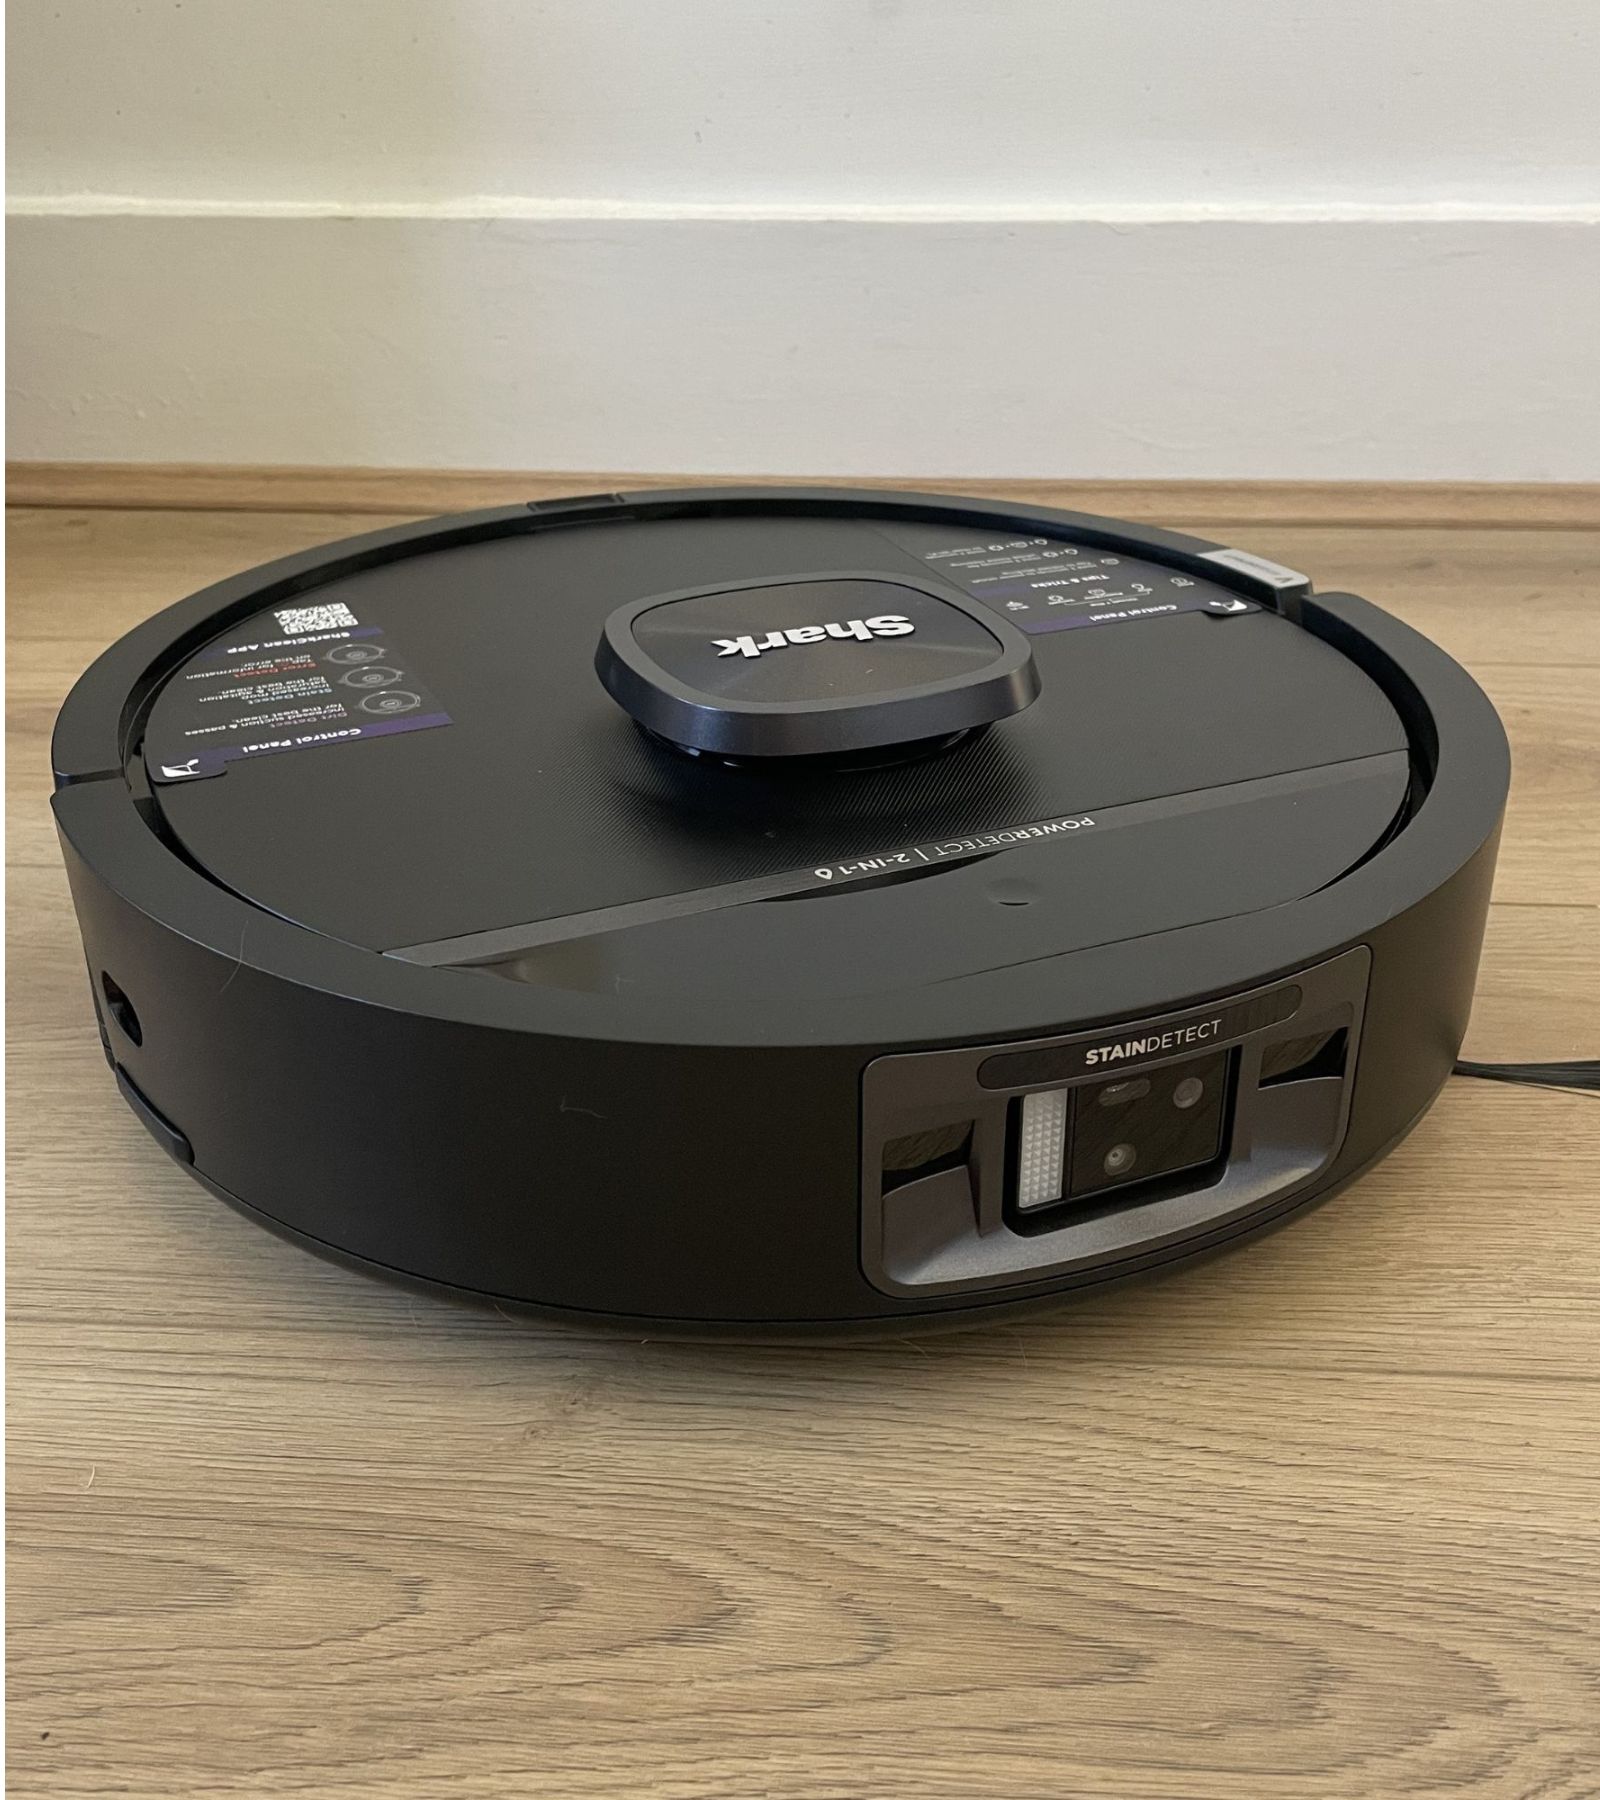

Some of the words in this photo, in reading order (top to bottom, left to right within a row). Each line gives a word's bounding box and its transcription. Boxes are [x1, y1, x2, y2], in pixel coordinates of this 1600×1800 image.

[1089, 611, 1128, 622] Panel
[1127, 604, 1178, 617] Control
[263, 632, 350, 648] SharkClean
[710, 615, 916, 658] Shark
[227, 644, 258, 654] APP
[247, 693, 295, 705] Detect
[297, 687, 333, 698] Stain
[270, 717, 317, 728] Detect
[184, 725, 226, 736] passes
[296, 728, 362, 745] Control
[242, 739, 292, 754] Panel
[935, 816, 1097, 857] POWERDETECT
[838, 853, 911, 876] 2-IN-1
[1084, 1018, 1223, 1066] STAINDETECT
